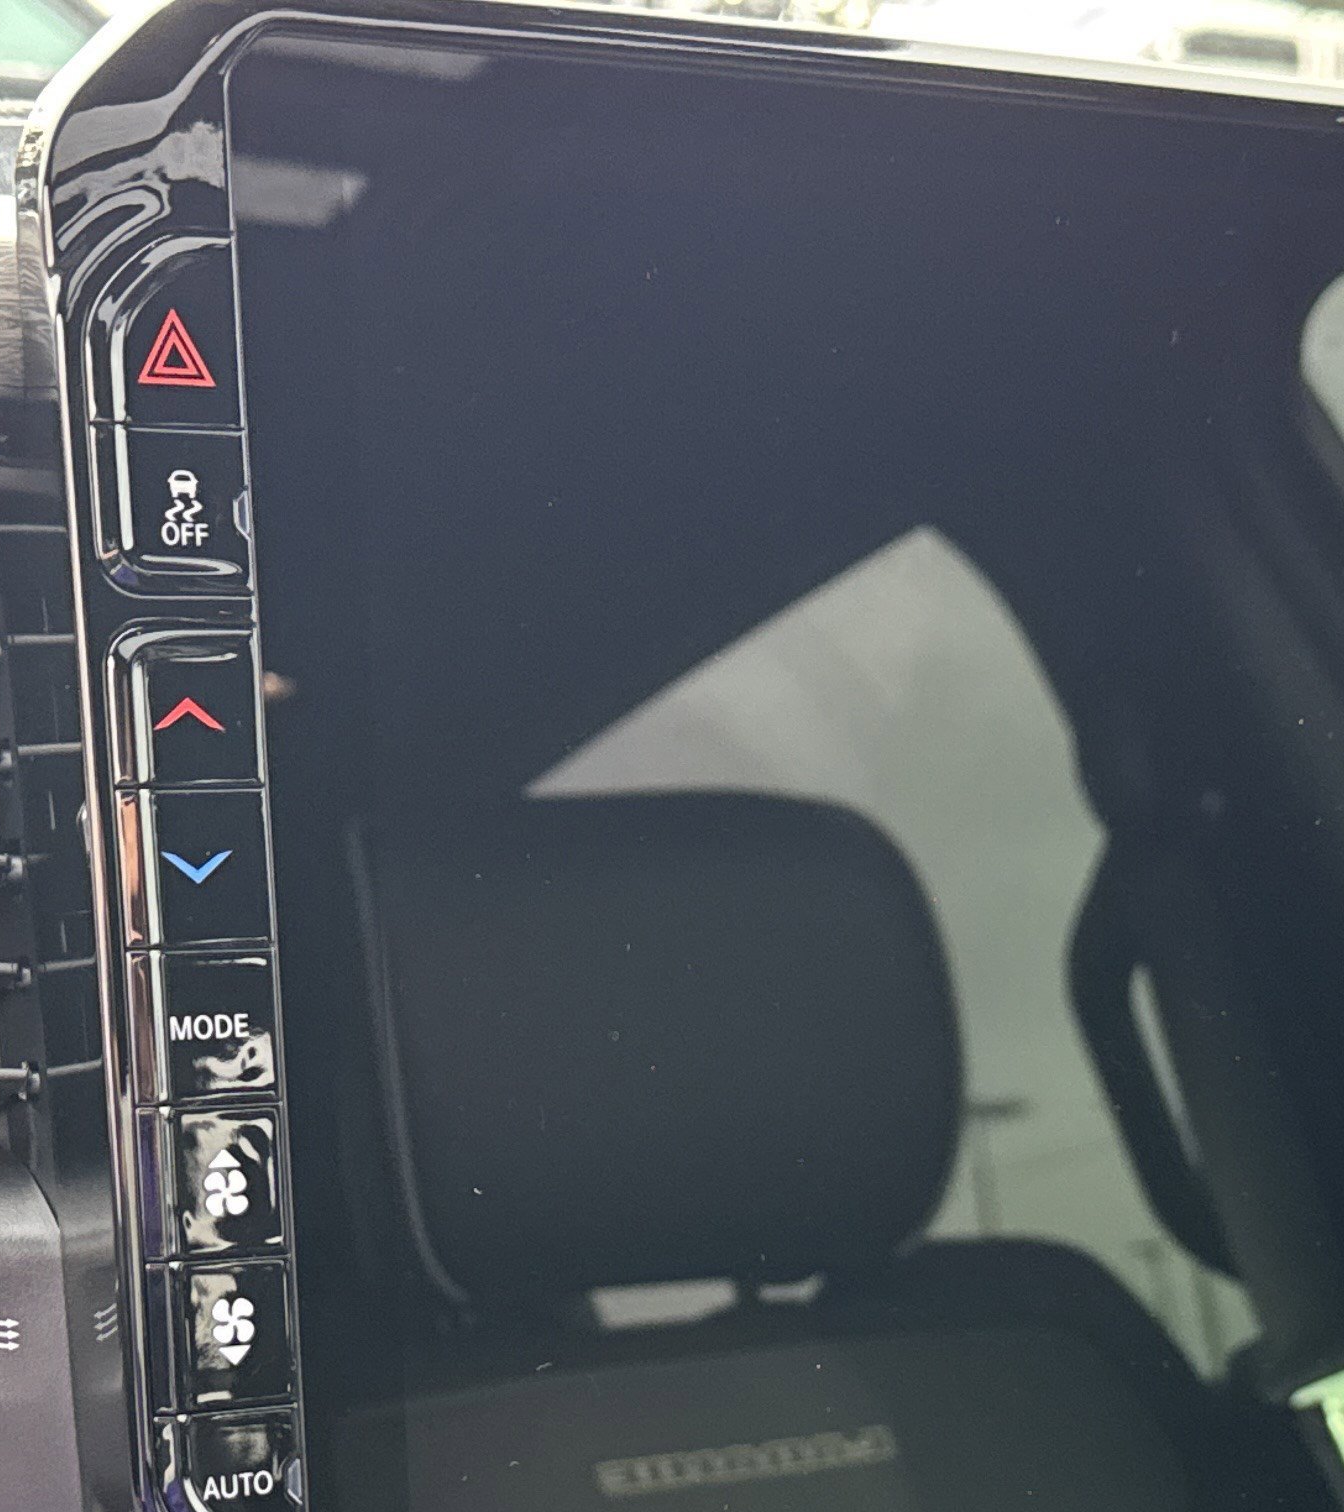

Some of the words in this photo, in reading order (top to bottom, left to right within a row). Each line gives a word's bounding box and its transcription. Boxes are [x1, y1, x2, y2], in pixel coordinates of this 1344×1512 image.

[161, 523, 209, 546] OFF
[169, 1013, 249, 1041] MODE
[203, 1470, 274, 1501] AUTO
